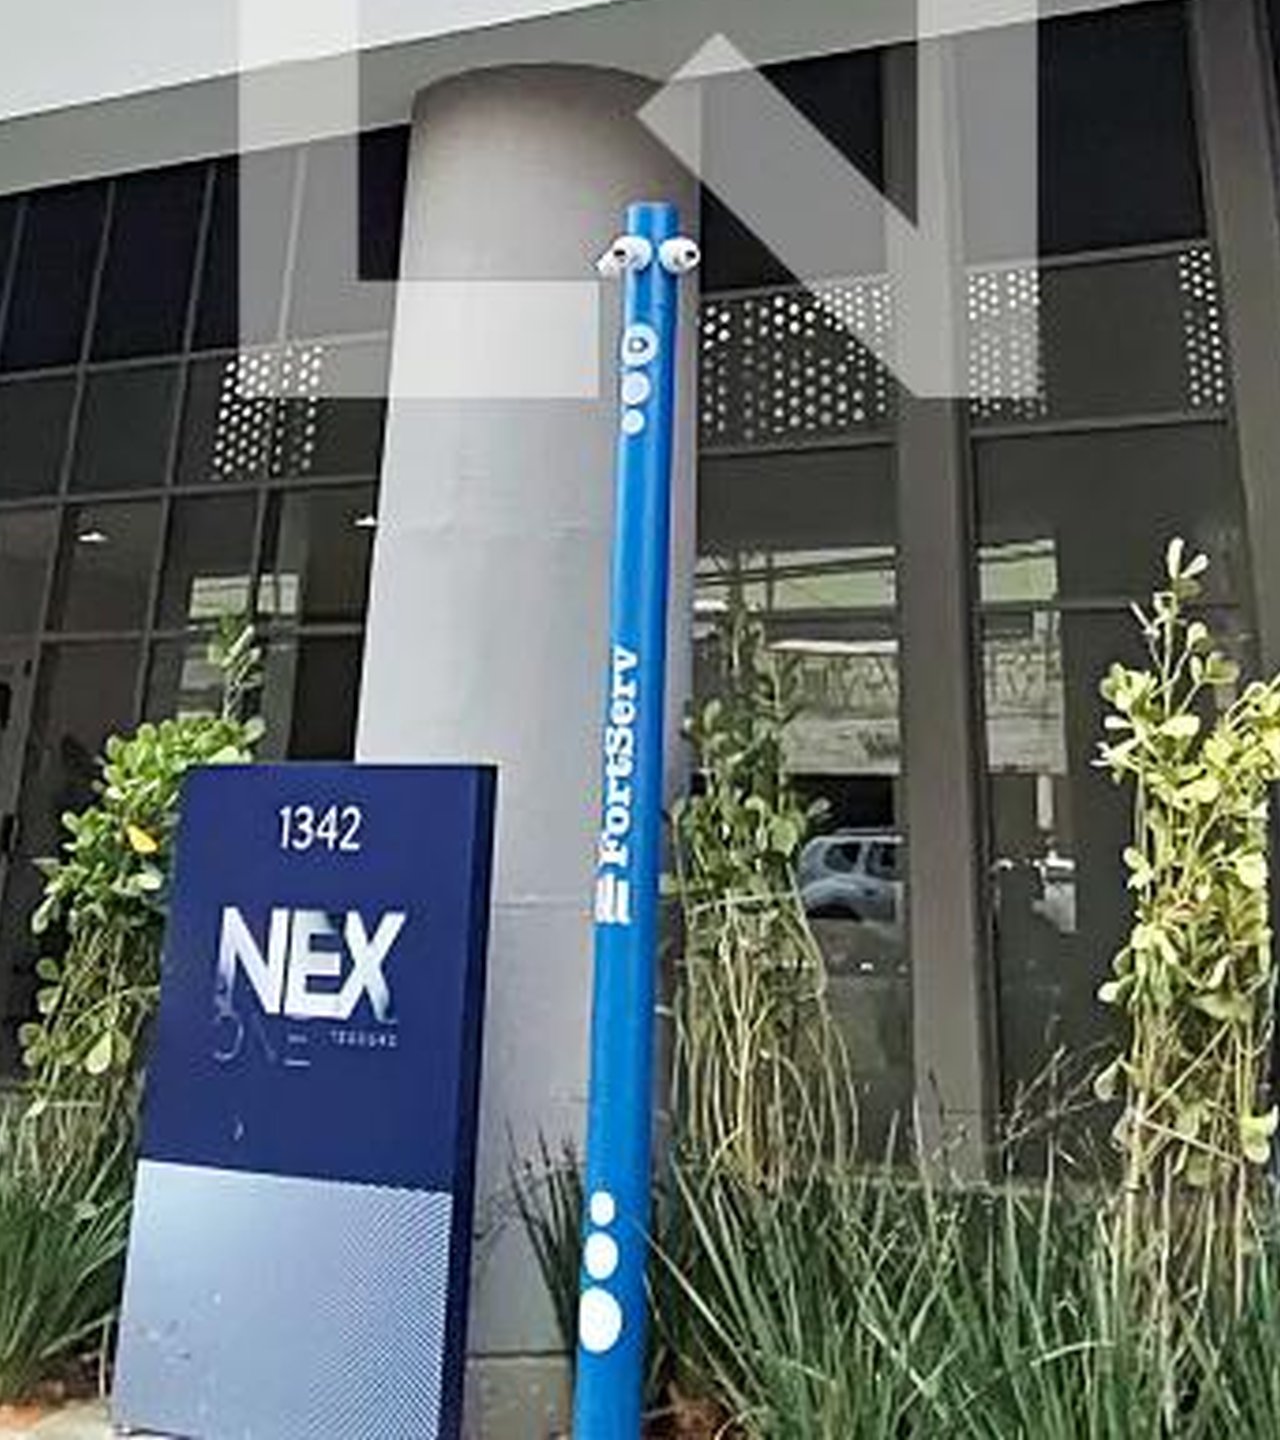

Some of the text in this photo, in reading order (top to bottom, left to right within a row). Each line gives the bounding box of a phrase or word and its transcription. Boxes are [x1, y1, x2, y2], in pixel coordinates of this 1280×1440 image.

[597, 644, 638, 867] FortServ
[279, 805, 362, 851] 1342
[218, 906, 406, 1023] NEX
